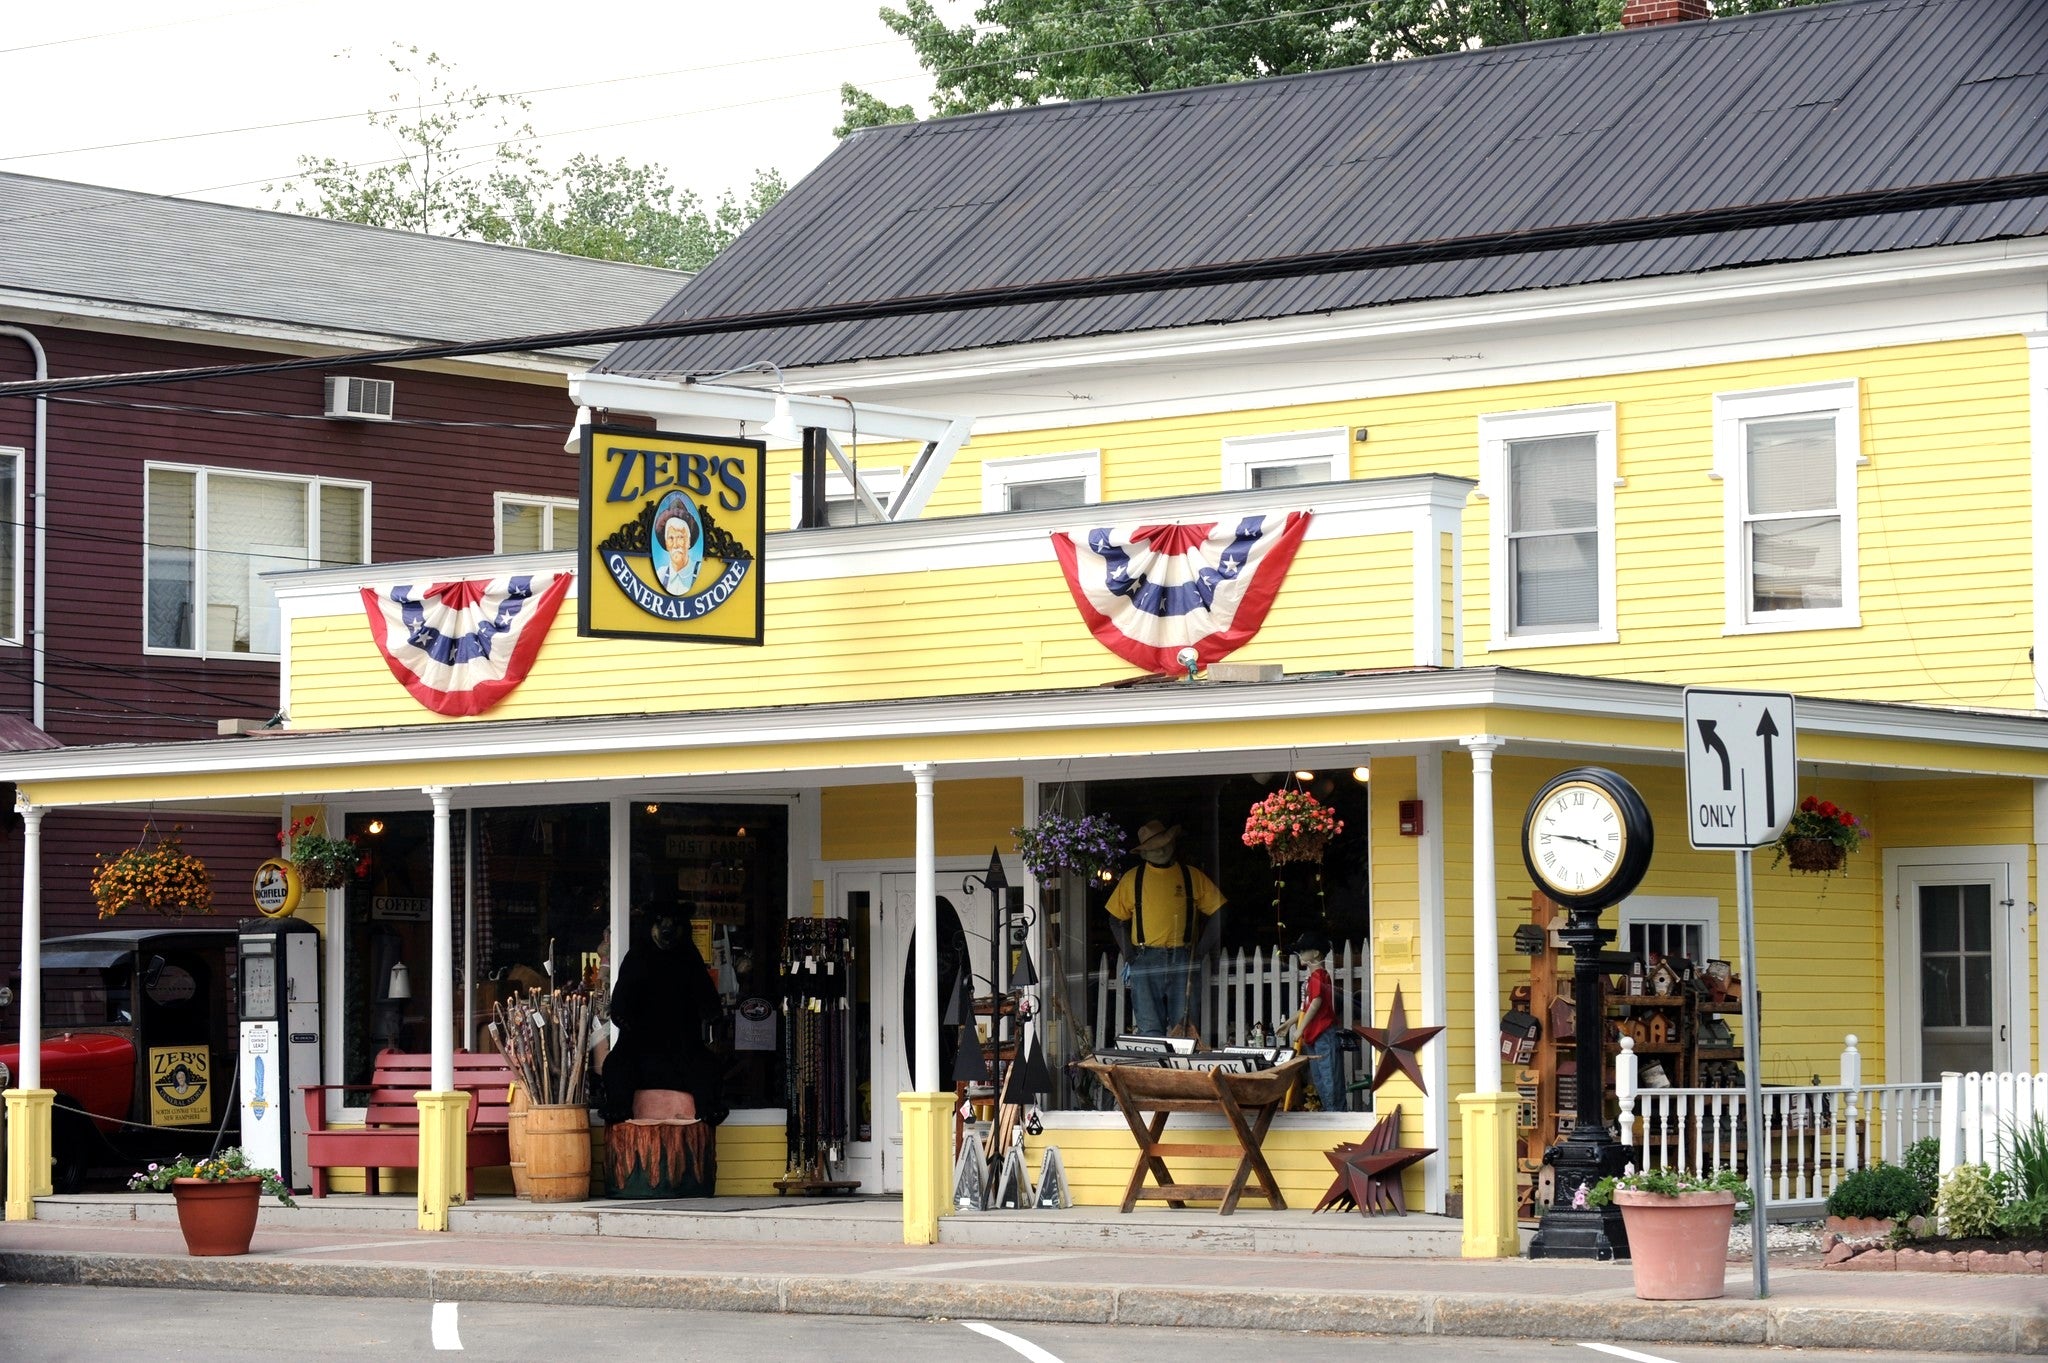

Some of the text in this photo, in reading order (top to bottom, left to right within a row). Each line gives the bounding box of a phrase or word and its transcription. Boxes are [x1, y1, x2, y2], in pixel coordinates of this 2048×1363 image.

[606, 447, 747, 511] ZEB'S
[609, 553, 745, 619] GENERAL STORE
[1699, 804, 1736, 828] ONLY
[669, 839, 704, 853] POST
[700, 871, 740, 885] JAMS
[376, 898, 427, 911] COFFEE
[699, 903, 739, 917] ANDY
[154, 1052, 207, 1074] ZEB'S
